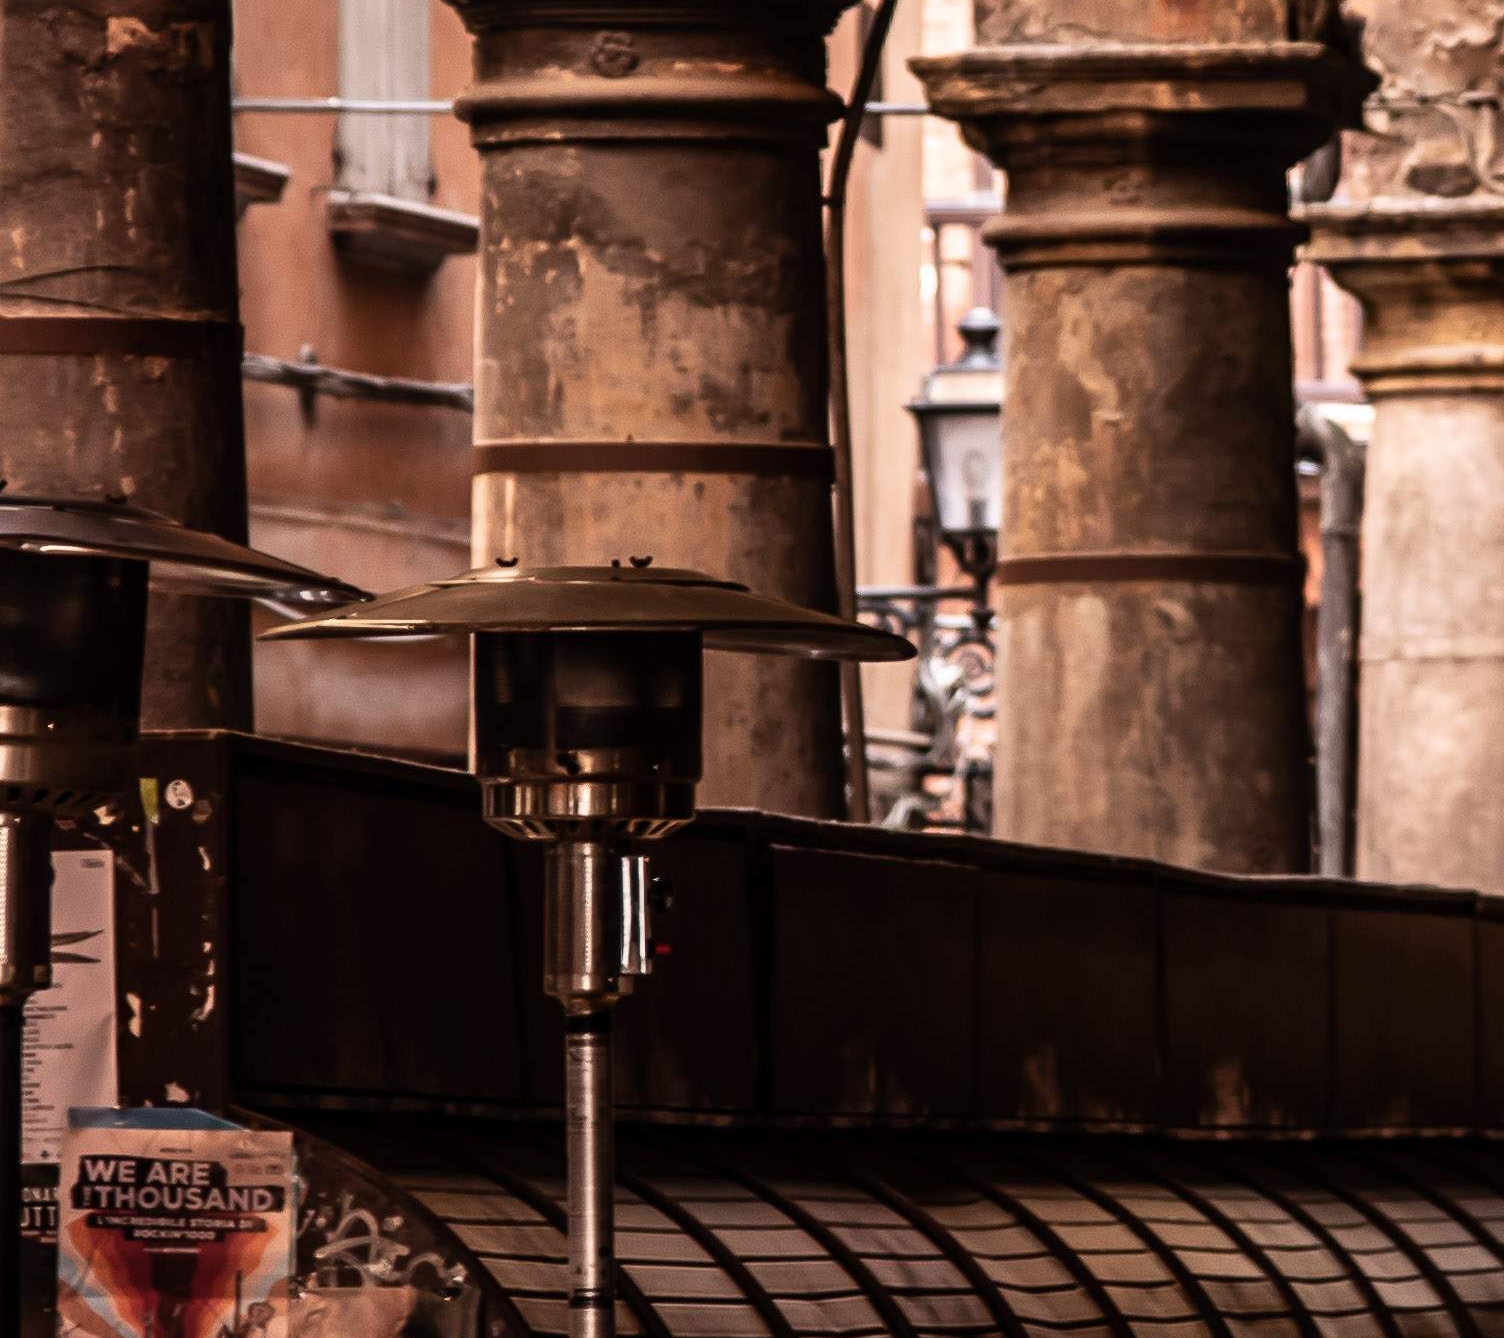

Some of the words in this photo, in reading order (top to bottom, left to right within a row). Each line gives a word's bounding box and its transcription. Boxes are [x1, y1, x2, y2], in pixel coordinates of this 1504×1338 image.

[85, 1159, 136, 1184] WE
[147, 1162, 211, 1186] ARE
[93, 1185, 274, 1212] THOUSAND
